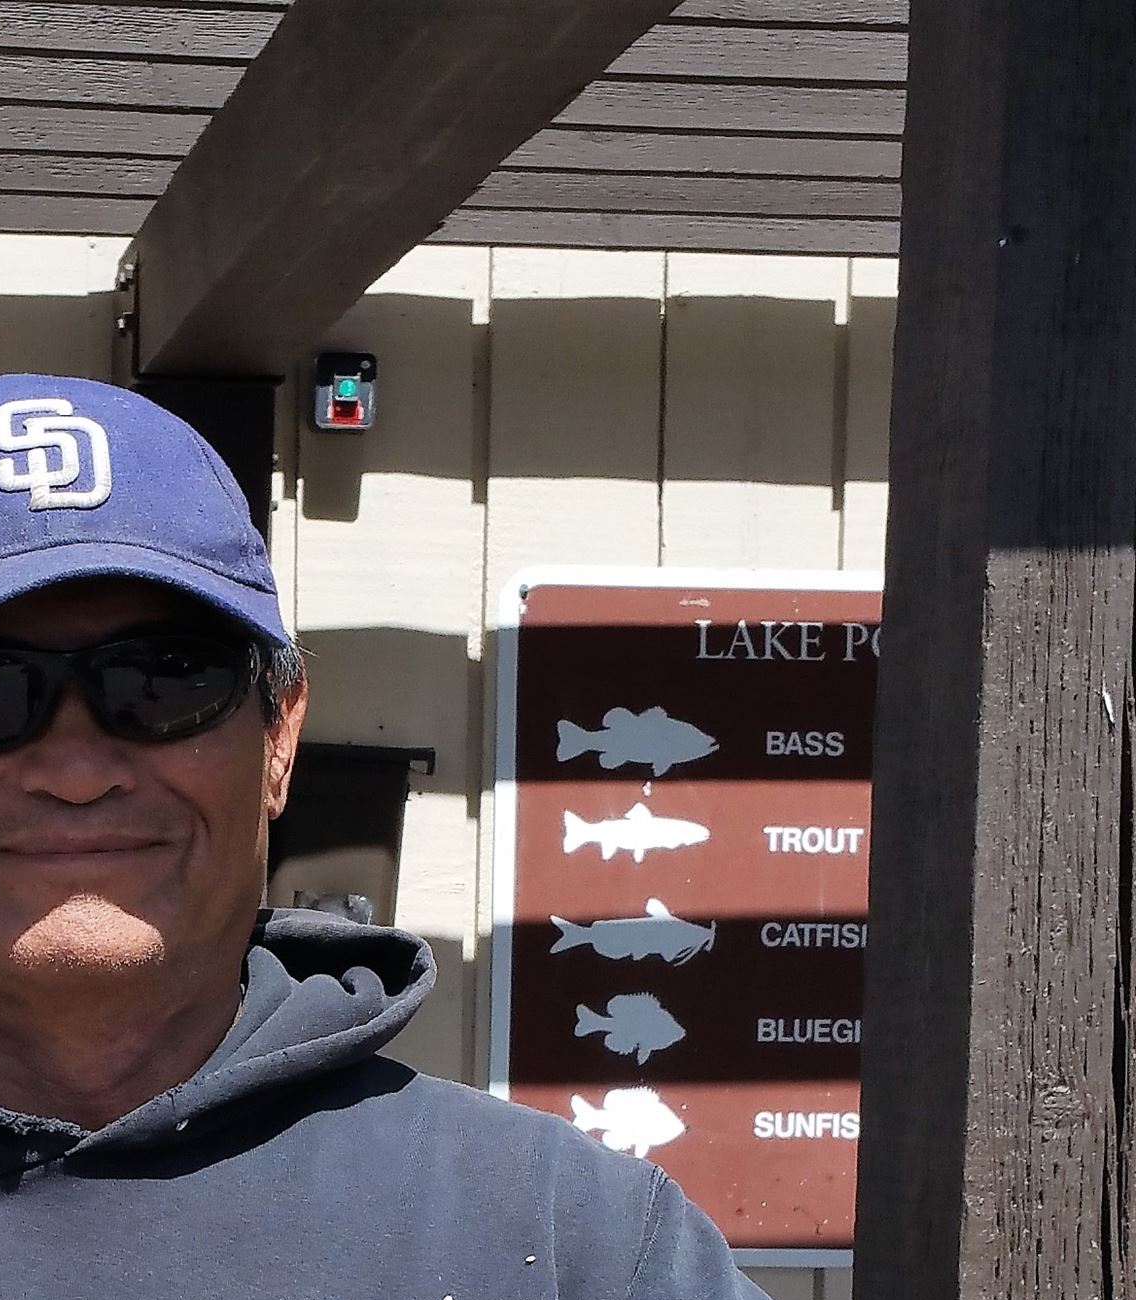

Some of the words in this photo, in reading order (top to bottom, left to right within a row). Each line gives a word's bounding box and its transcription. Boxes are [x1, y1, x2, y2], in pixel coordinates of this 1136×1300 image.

[695, 619, 826, 661] LAKE
[842, 622, 881, 661] P
[766, 731, 845, 756] BASS
[763, 826, 864, 853] TROUT
[753, 1111, 861, 1139] SUNFIS
